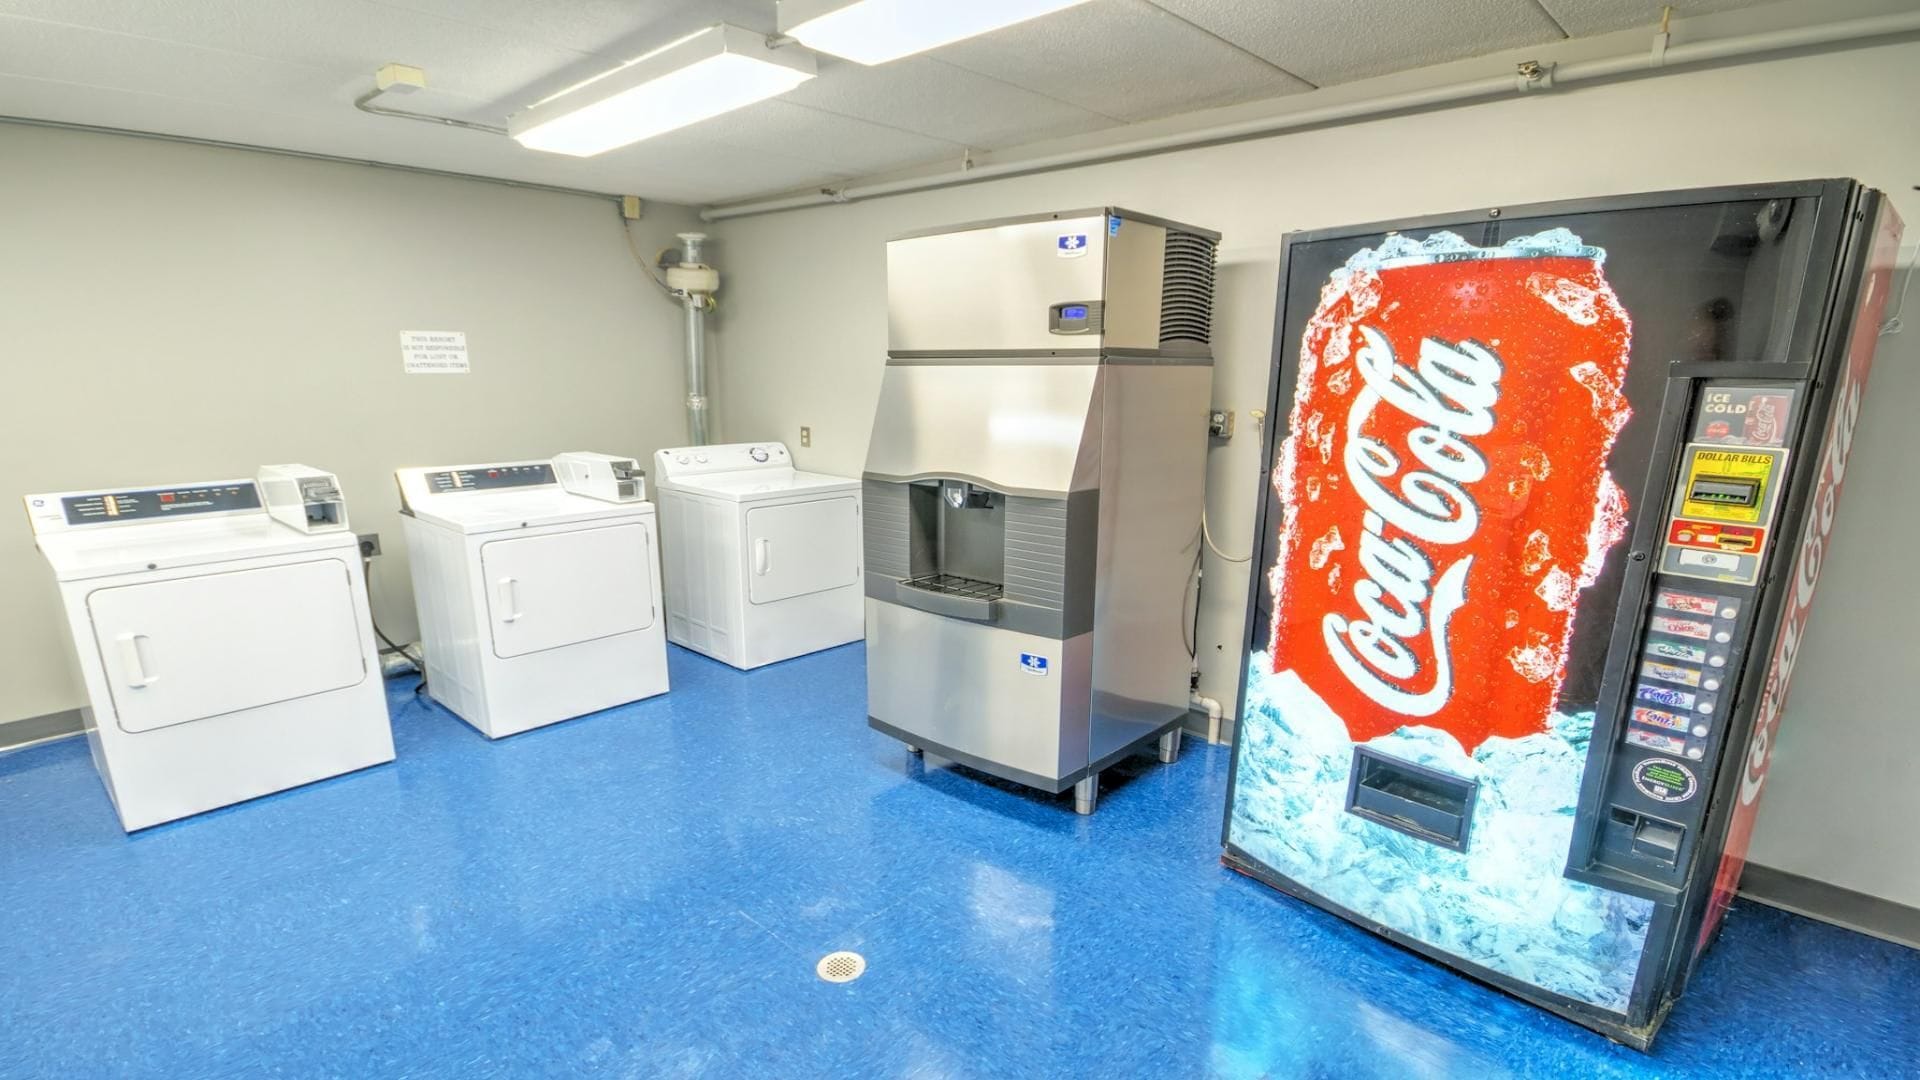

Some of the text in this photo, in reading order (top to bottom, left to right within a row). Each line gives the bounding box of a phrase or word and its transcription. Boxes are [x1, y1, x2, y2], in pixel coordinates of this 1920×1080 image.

[1707, 393, 1731, 403] ICE
[1705, 403, 1747, 414] COLD
[1697, 452, 1772, 465] DOLLAR BILLS
[1322, 324, 1505, 718] Coca-Cola
